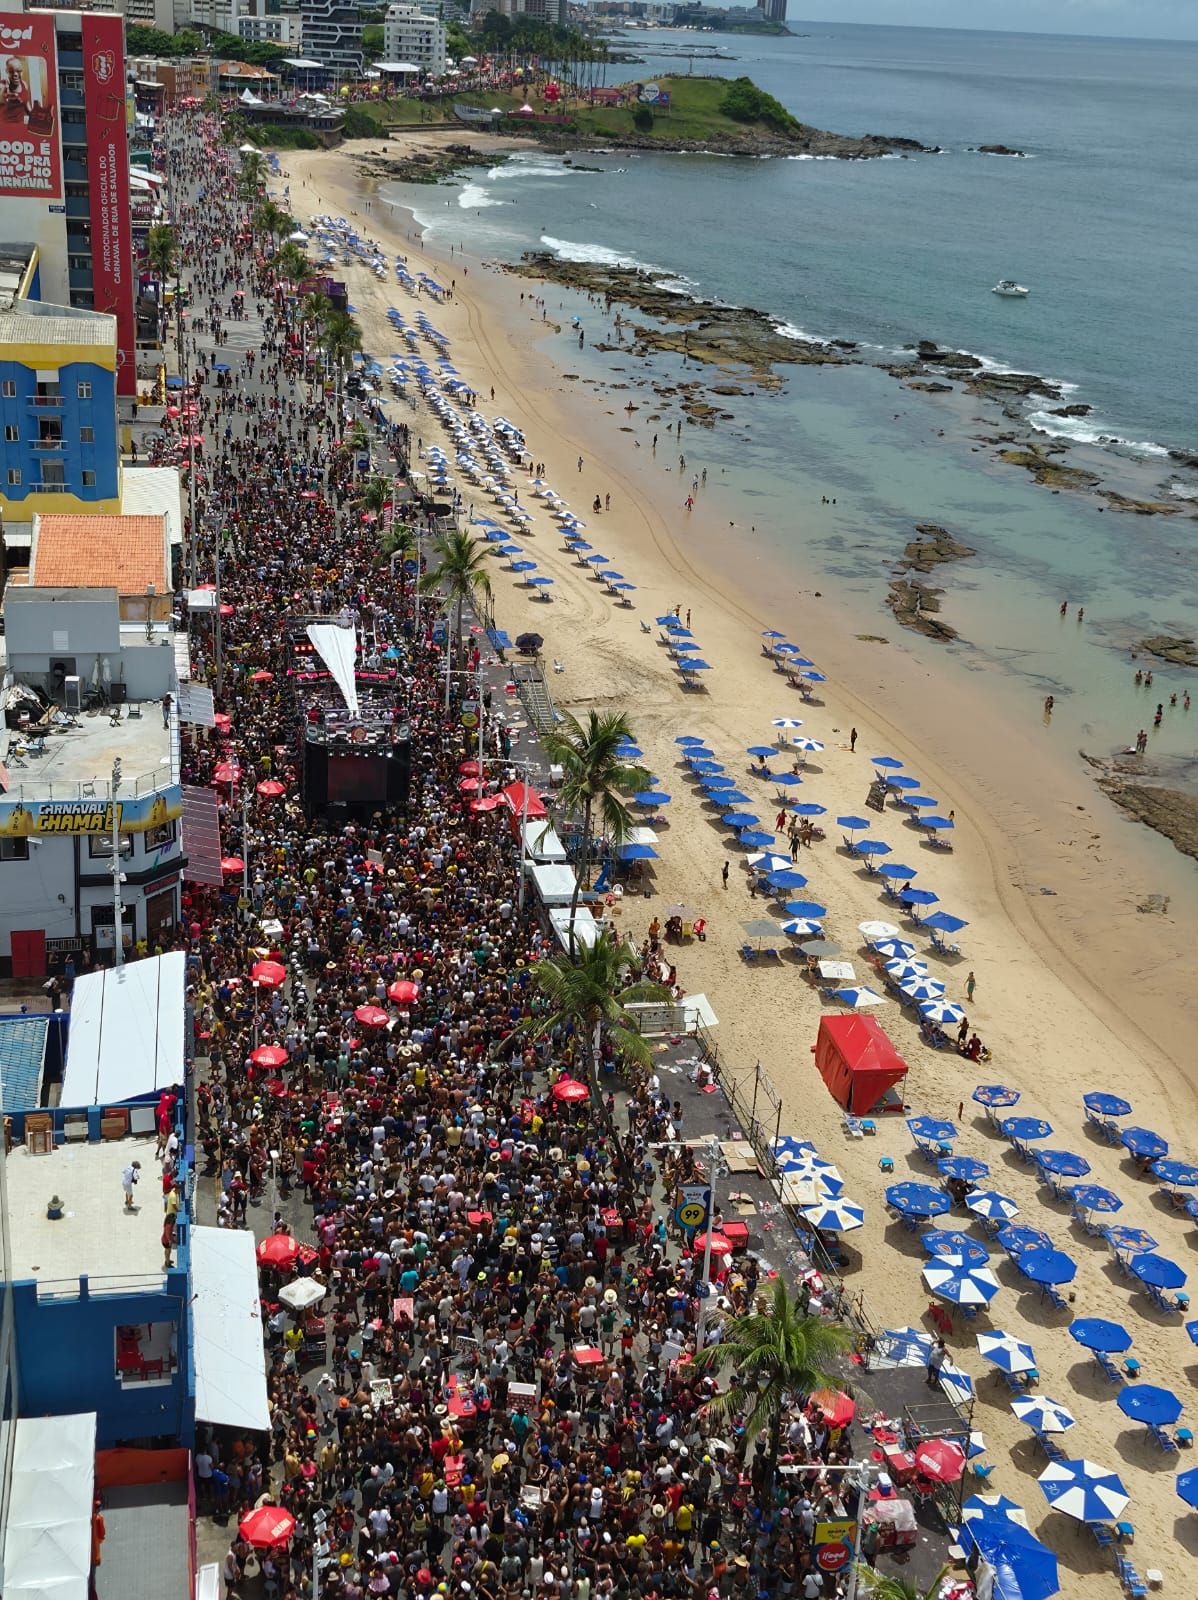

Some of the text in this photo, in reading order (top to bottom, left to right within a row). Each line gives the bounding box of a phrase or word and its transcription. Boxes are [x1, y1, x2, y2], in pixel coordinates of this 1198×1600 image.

[40, 139, 51, 156] É
[25, 155, 51, 167] PRA
[0, 165, 52, 178] M NO
[99, 155, 111, 272] PATROCINADOR OFICIAL DO
[108, 143, 121, 284] CARNAVAL DE RUA DE SALVADOR
[137, 205, 151, 213] PIER
[39, 804, 105, 815] CARNAVAL
[38, 814, 103, 831] CHAMA
[685, 1209, 700, 1219] 99
[1044, 1482, 1061, 1496] 30
